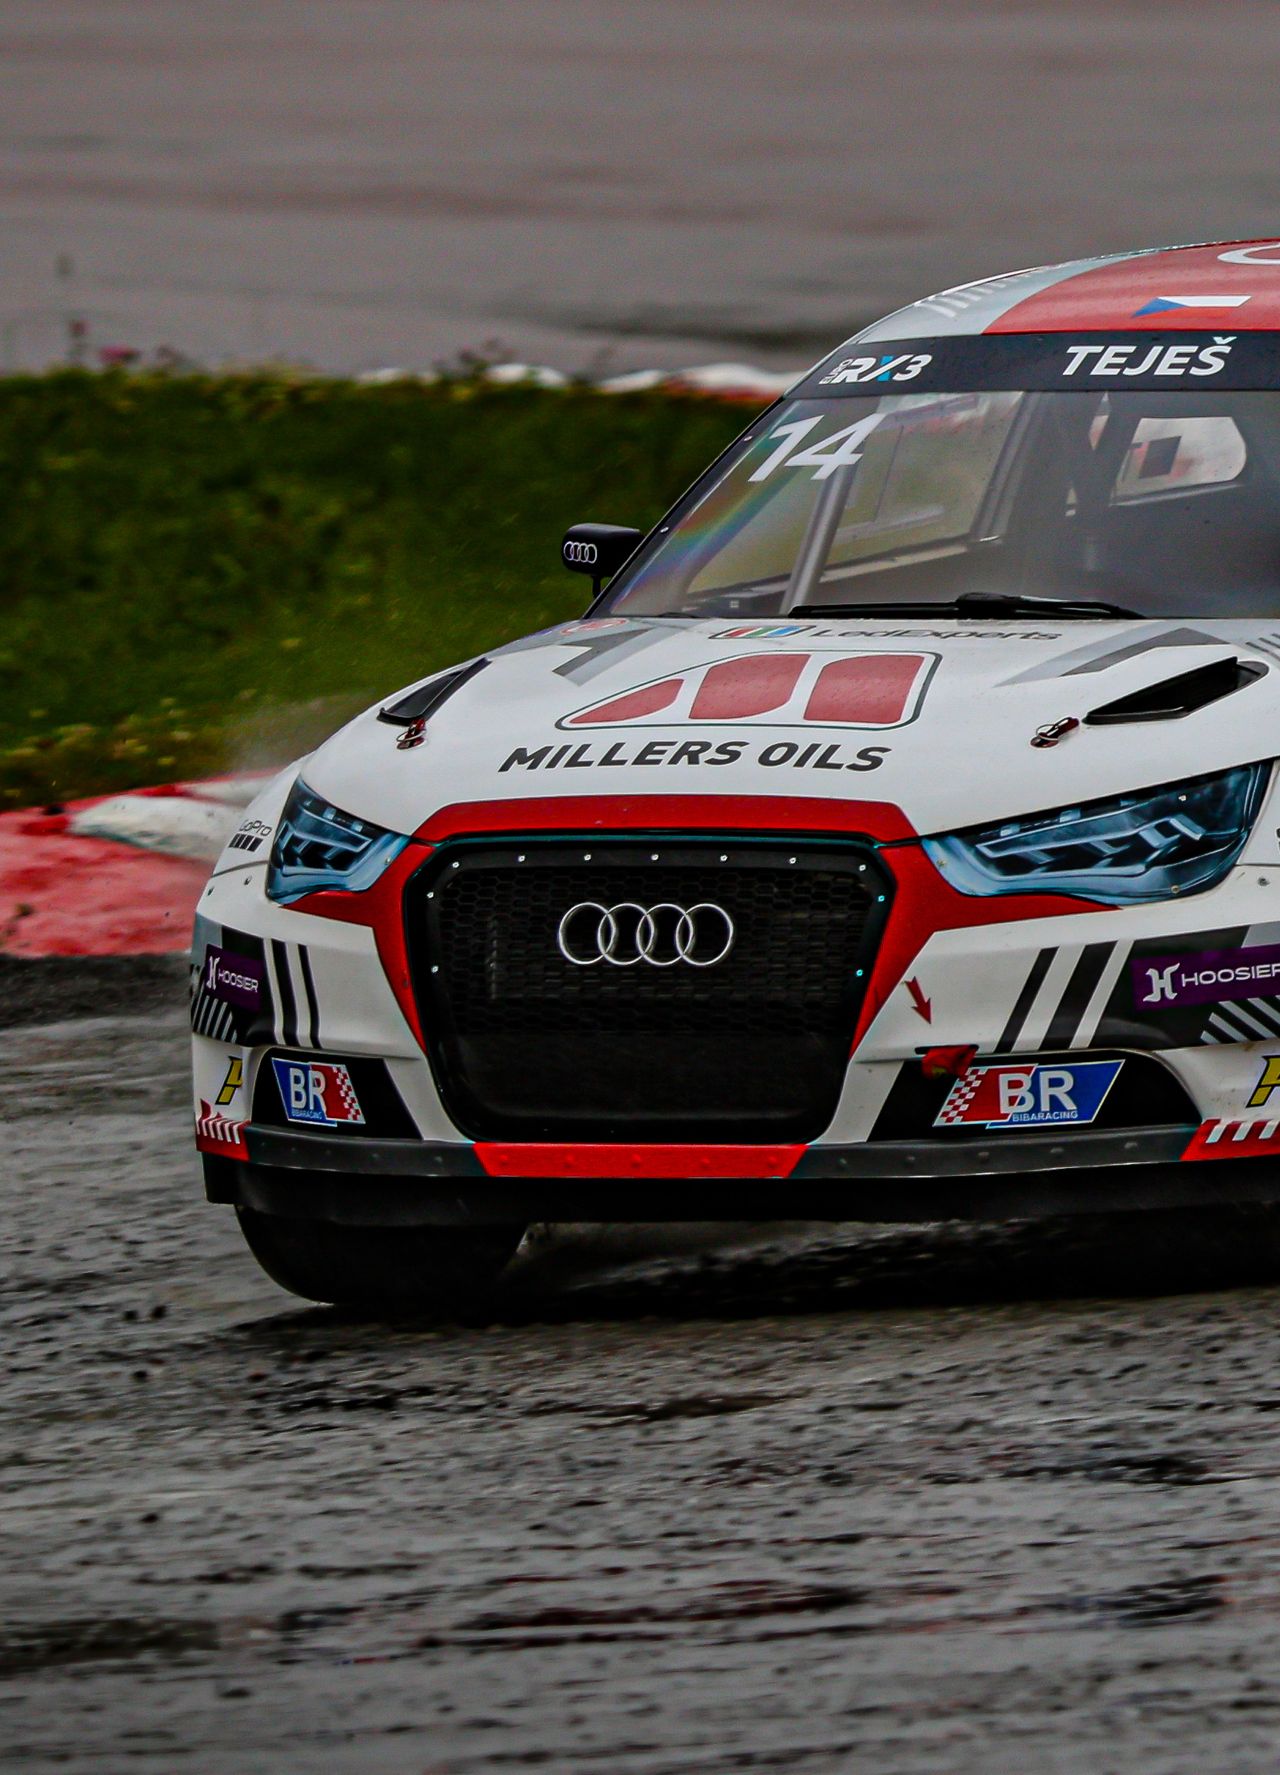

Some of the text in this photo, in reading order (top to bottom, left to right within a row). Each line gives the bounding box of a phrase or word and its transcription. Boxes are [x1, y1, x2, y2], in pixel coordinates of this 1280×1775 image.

[831, 354, 932, 384] RX3
[1062, 336, 1238, 377] TEJEŠ
[748, 412, 888, 482] 14
[814, 627, 1062, 641] LedExperts
[498, 740, 892, 773] MILLERS OILS
[217, 968, 259, 993] HOOSIER
[289, 1067, 327, 1111] BR
[998, 1070, 1078, 1114] BR
[1012, 1110, 1078, 1122] BIBARACING
